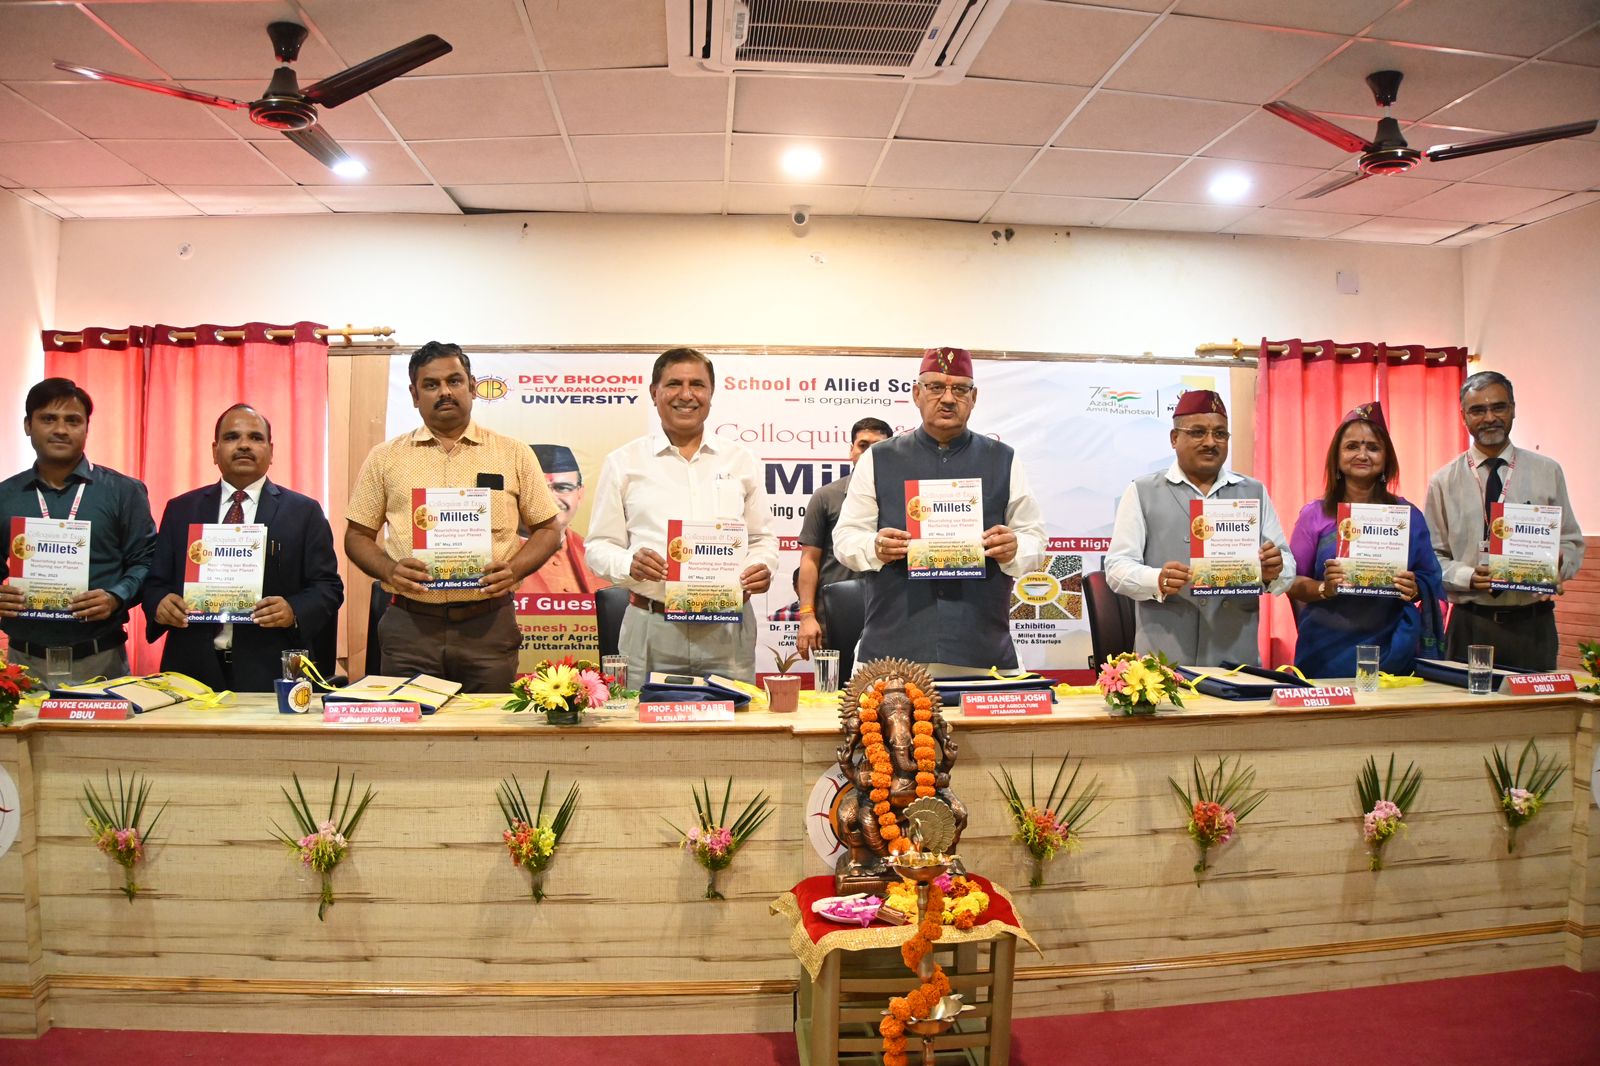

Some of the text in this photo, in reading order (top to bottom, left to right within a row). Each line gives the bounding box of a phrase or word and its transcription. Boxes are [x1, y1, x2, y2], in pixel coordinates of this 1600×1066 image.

[518, 375, 643, 384] DEV BHOOMI
[724, 376, 791, 391] School
[799, 377, 817, 391] of
[824, 378, 880, 392] Allied
[521, 395, 638, 404] UNIVERSITY
[804, 396, 891, 406] is organizing
[1110, 408, 1156, 416] Mahotsav
[715, 423, 851, 450] Colloquiu
[933, 503, 971, 512] Millets
[440, 512, 480, 522] Millets
[1216, 522, 1250, 532] Millets
[1362, 525, 1399, 536] Millets
[1515, 524, 1550, 535] Millets
[26, 542, 78, 554] On Millets
[1047, 540, 1076, 548] vent
[202, 547, 253, 558] On Millets
[694, 545, 734, 556] Millets
[434, 566, 467, 574] Souvenir
[204, 599, 256, 608] Souvenir Boo
[686, 599, 718, 607] Souvenir
[572, 624, 597, 632] Jos
[1527, 674, 1571, 683] CHANCELLOR
[1276, 687, 1352, 698] CHANCELLOR
[1533, 684, 1555, 692] DBUU
[966, 695, 986, 703] SHRI
[987, 694, 1021, 702] GANESH
[1303, 698, 1330, 707] DBUU
[42, 701, 58, 709] PRO
[59, 701, 77, 709] VICE
[647, 705, 672, 713] PROF.
[674, 704, 700, 712] SUNIL
[69, 711, 95, 719] DBUU
